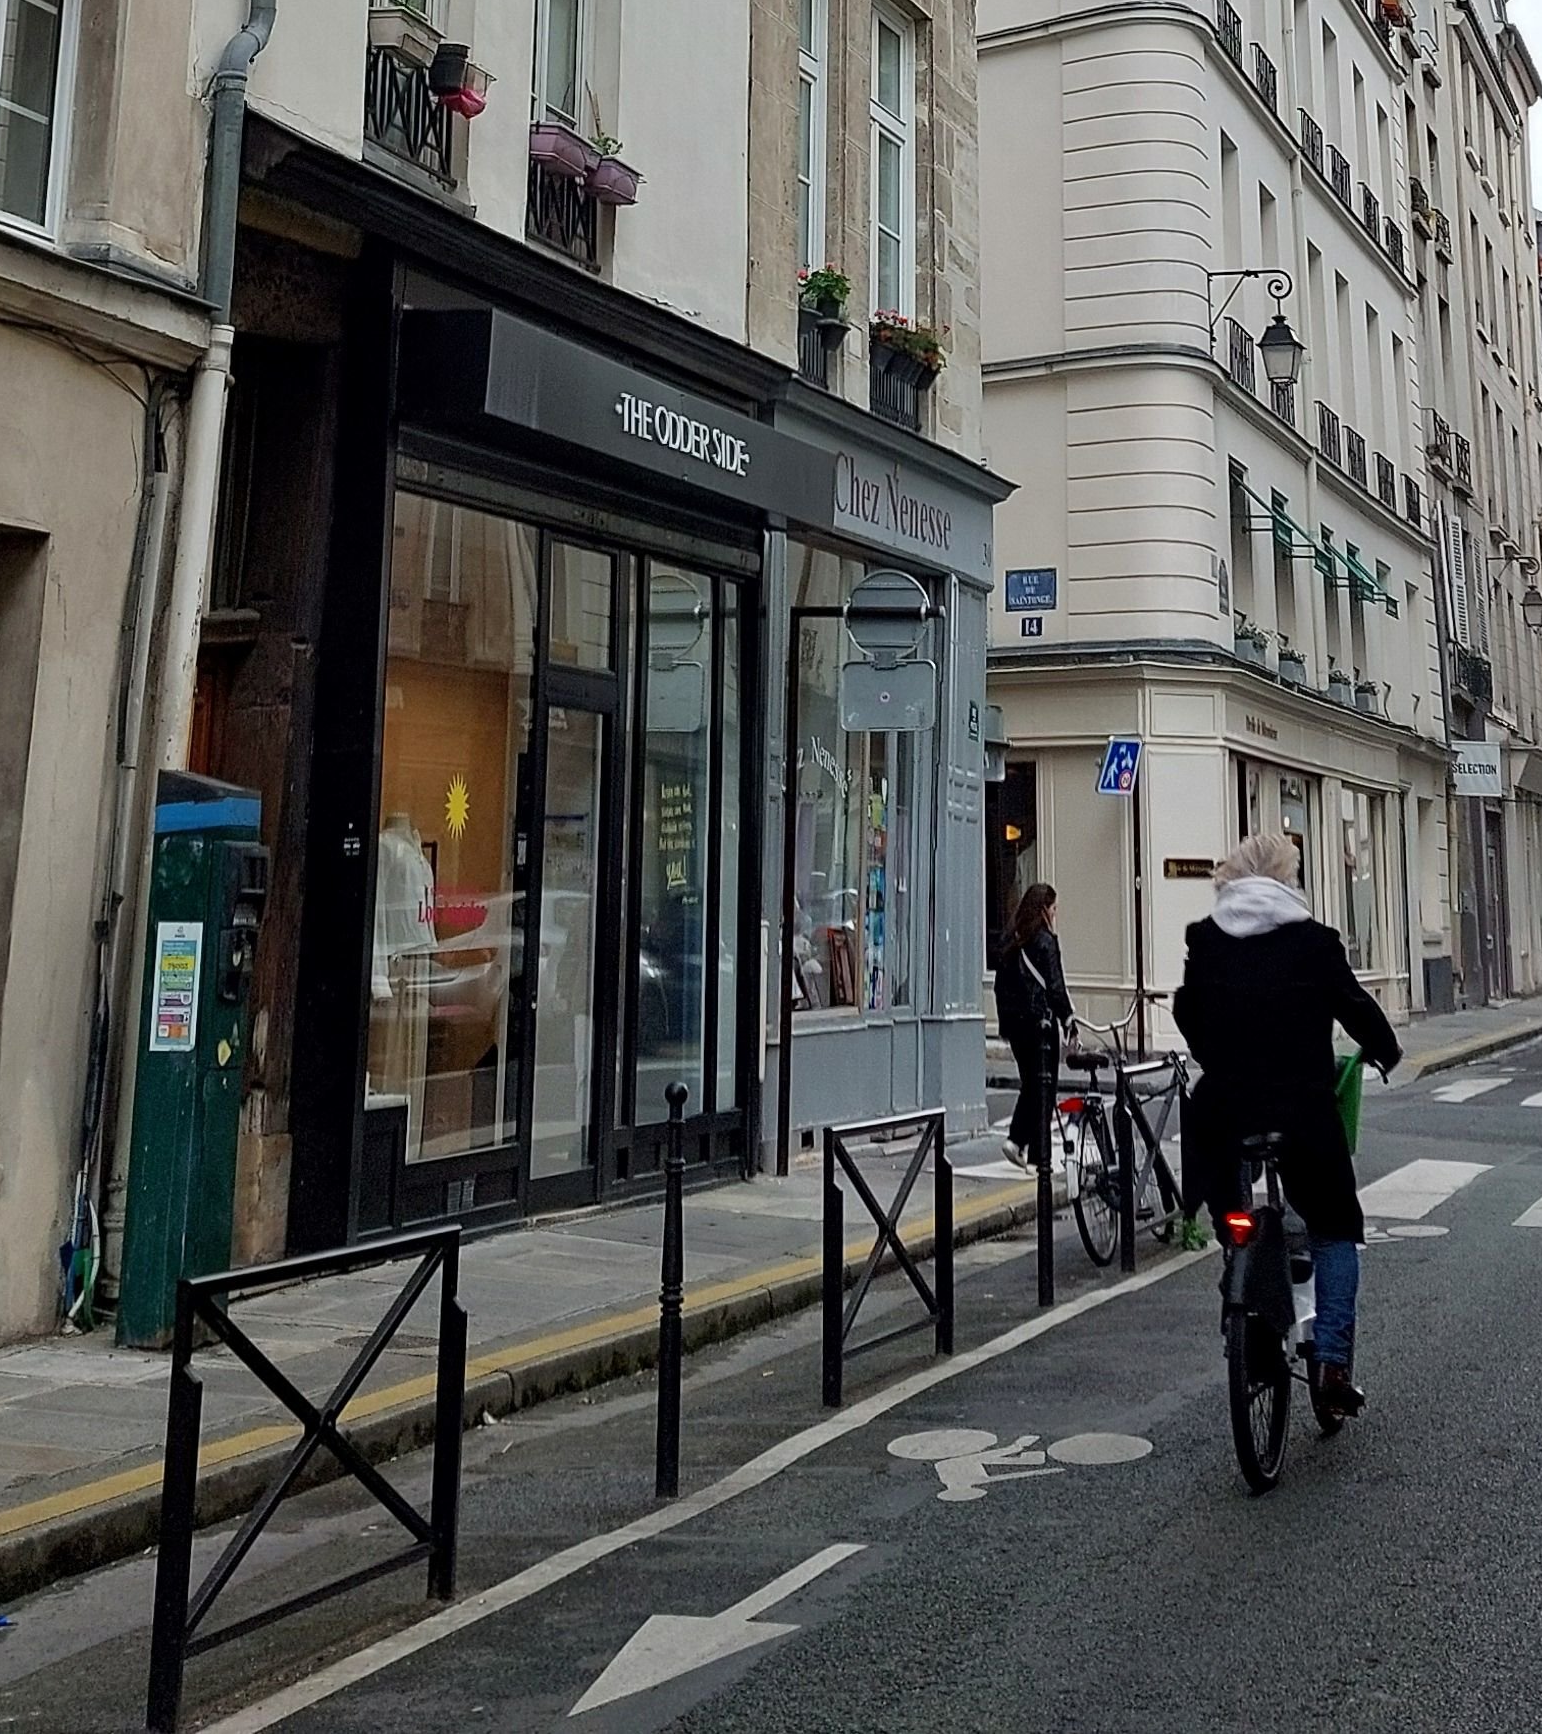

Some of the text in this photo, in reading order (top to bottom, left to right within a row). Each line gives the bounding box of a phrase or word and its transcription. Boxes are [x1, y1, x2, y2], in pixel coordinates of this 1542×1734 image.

[620, 392, 748, 478] THE ODDER SIDE
[835, 450, 880, 526] Chez
[1022, 575, 1040, 585] RUE
[1025, 618, 1039, 636] 14
